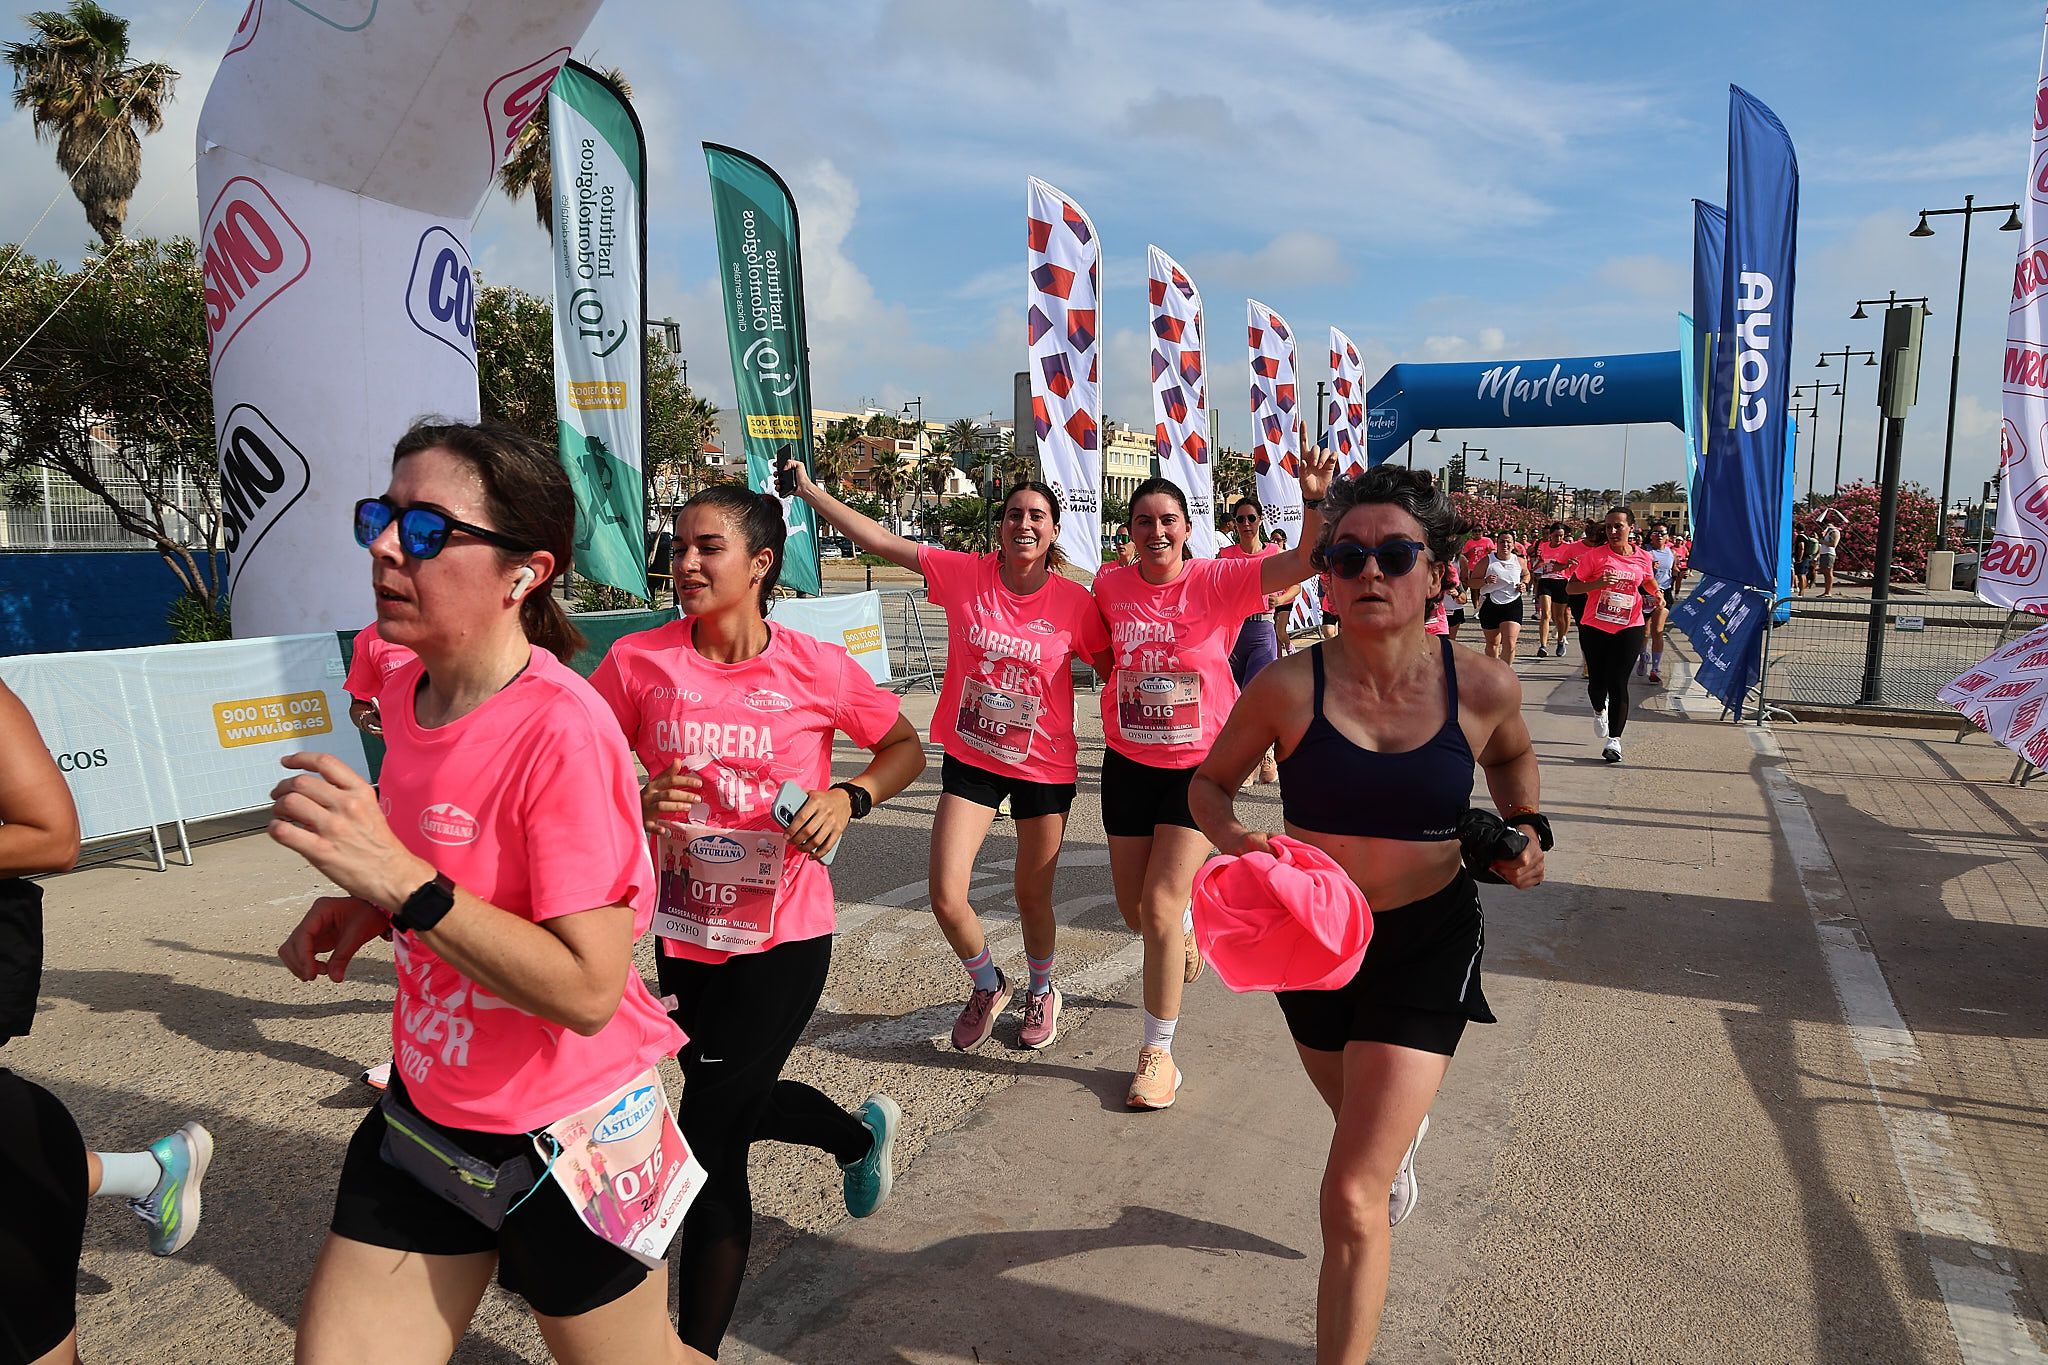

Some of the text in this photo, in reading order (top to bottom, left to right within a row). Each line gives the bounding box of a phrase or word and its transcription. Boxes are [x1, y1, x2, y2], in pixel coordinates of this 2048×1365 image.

[202, 199, 284, 356] SMO
[1477, 363, 1605, 418] Marlene
[211, 426, 285, 554] SMO
[974, 603, 1003, 621] OYSHO
[1113, 620, 1176, 642] CARRERA
[968, 623, 1041, 664] CARRERA
[654, 686, 703, 703] OYSHO
[1141, 682, 1173, 690] ASTURIANA
[221, 698, 322, 724] 900 131 002
[749, 697, 790, 708] ASTURIANA
[983, 695, 1013, 709] ASTURIANA
[1142, 705, 1175, 718] 016
[226, 715, 325, 740] www.ioa.es
[978, 717, 1008, 736] 016
[1128, 731, 1153, 740] OYSHO
[1168, 732, 1193, 740] Santander
[656, 719, 774, 760] CARRERA
[423, 814, 474, 839] ASTURIANA
[691, 842, 742, 859] ASTURIANA
[691, 880, 737, 904] 016
[668, 906, 758, 930] CARRERA DE LA MUJER VALENCIA
[701, 906, 723, 916] 1727
[666, 920, 700, 937] OYSHO
[721, 934, 757, 946] Santander
[615, 1143, 664, 1202] 016
